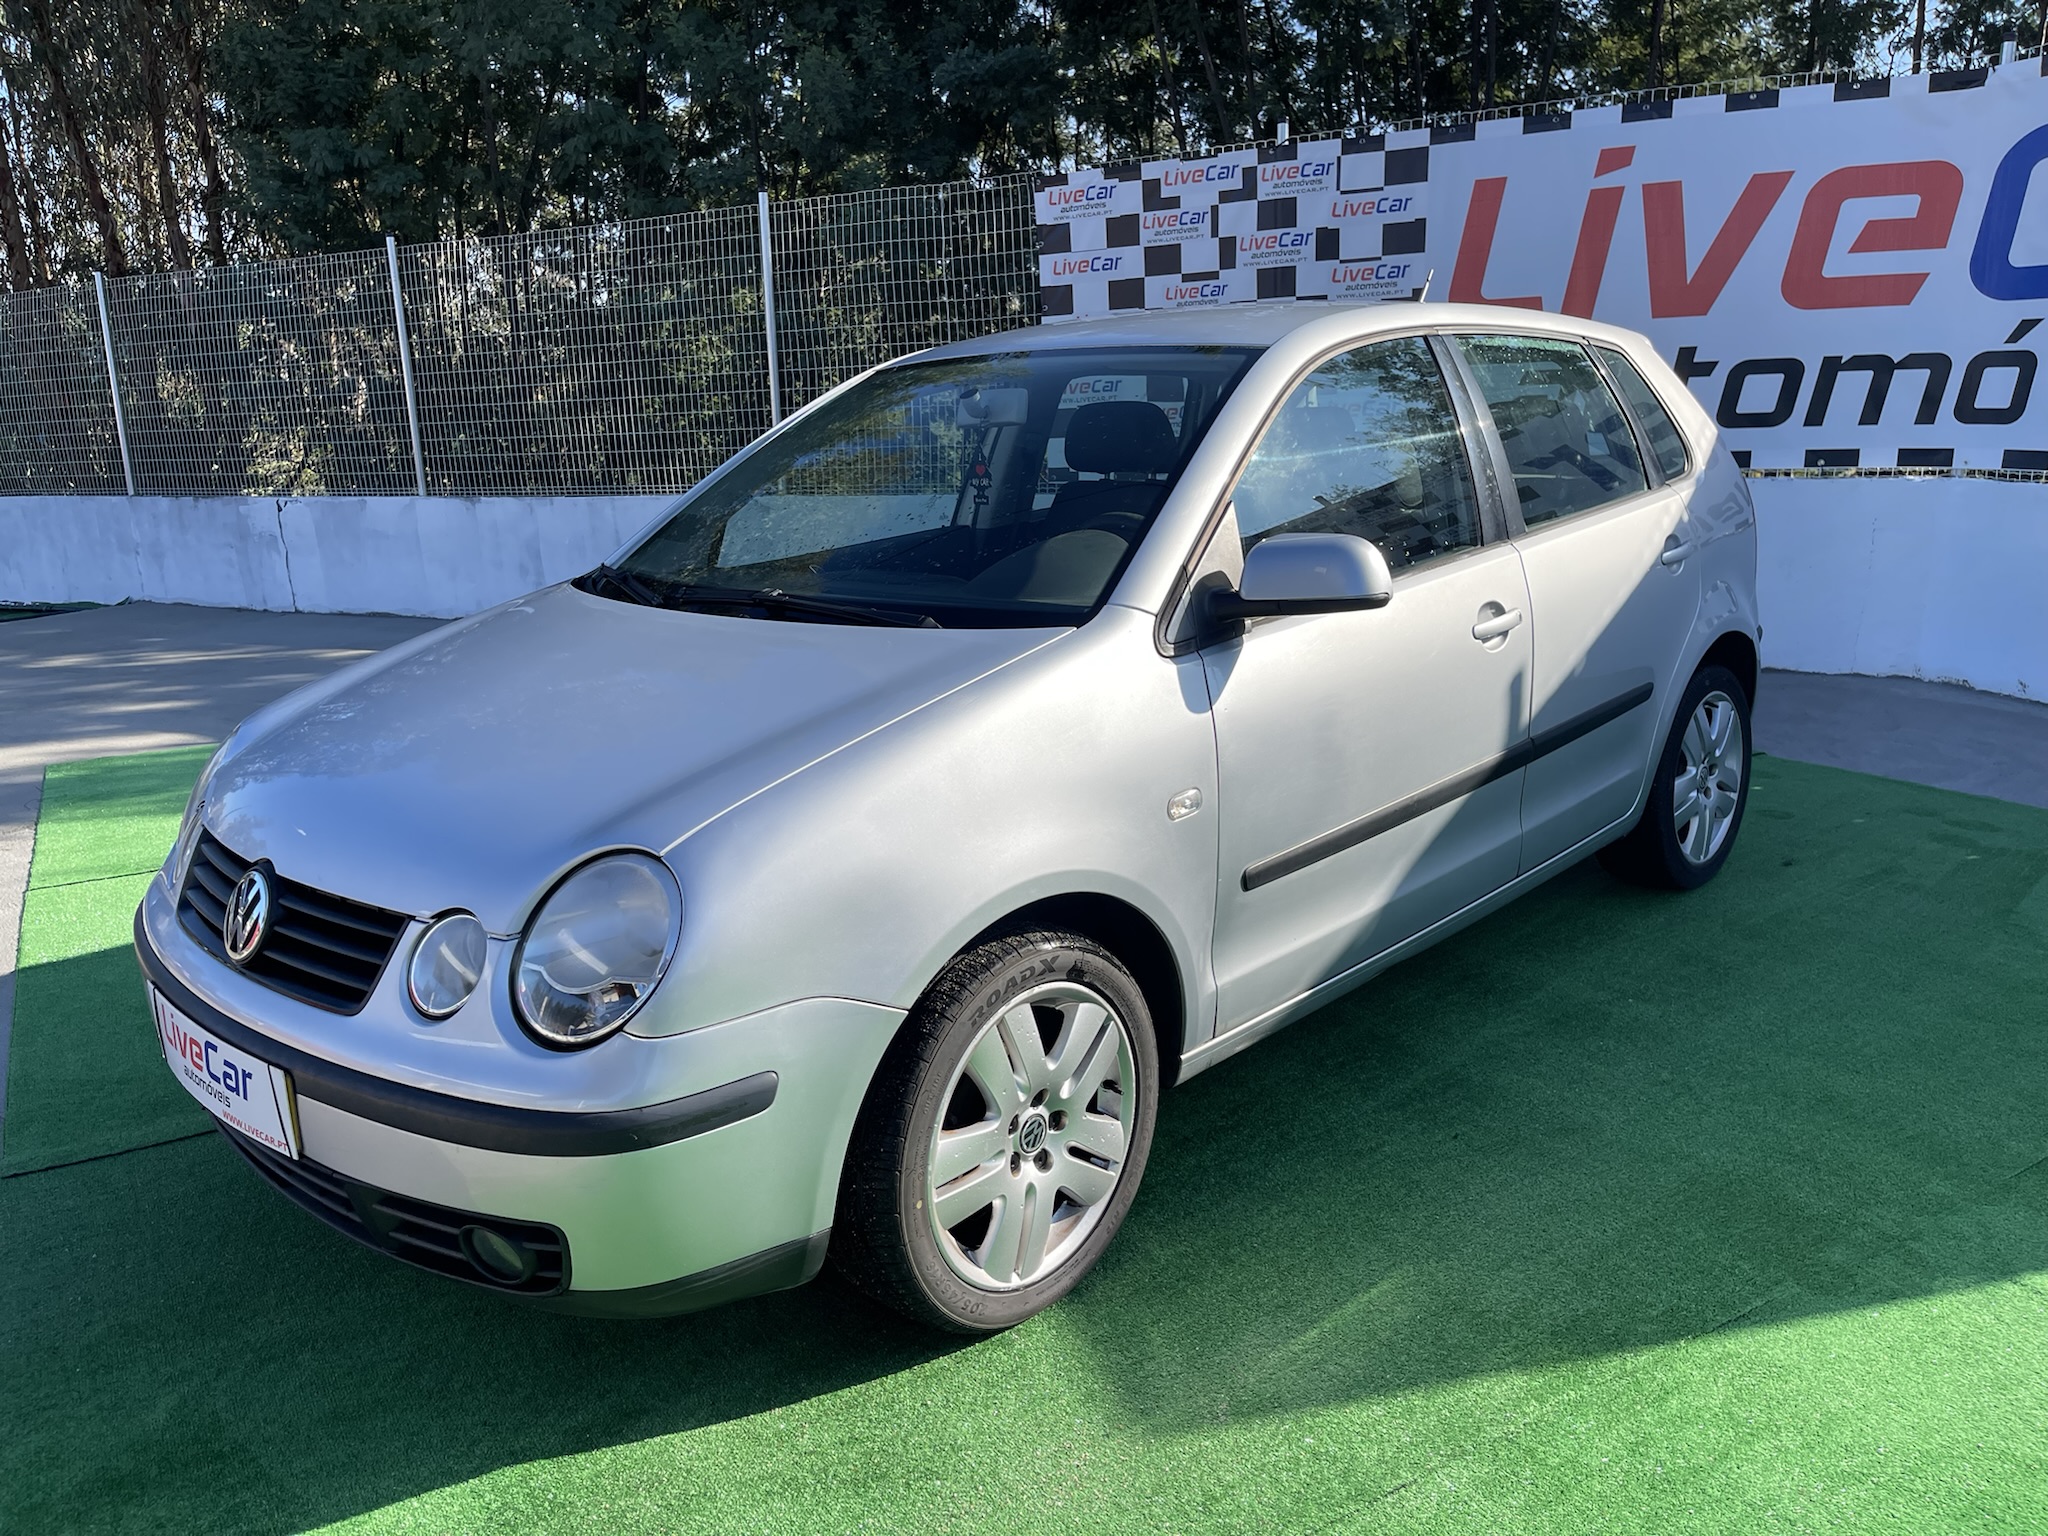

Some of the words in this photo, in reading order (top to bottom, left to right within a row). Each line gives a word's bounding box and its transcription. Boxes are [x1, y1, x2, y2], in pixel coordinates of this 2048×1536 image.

[1164, 164, 1239, 187] LiveCar
[1261, 162, 1335, 182] LiveCar
[1264, 186, 1329, 198] WWW.LIVECAR.PT
[1273, 178, 1324, 189] automóveis
[1049, 184, 1117, 206] LiveCar
[1331, 197, 1413, 218] LiveCar
[1143, 211, 1209, 230] LiveCar
[1239, 232, 1314, 252] LiveCar
[1251, 248, 1302, 260] automóveis
[1053, 256, 1122, 276] LiveCar
[1331, 264, 1411, 283] LiveCar
[1165, 284, 1229, 301] LiveCar
[1336, 289, 1404, 299] WWW.LIVECAR.PT
[1345, 280, 1398, 291] automóveis
[1064, 379, 1122, 395] veCar
[967, 955, 1061, 1028] ROADX
[161, 1004, 253, 1101] LiveCar
[183, 1065, 231, 1109] automóveis
[222, 1109, 288, 1152] WWW.LIVECAR.PT
